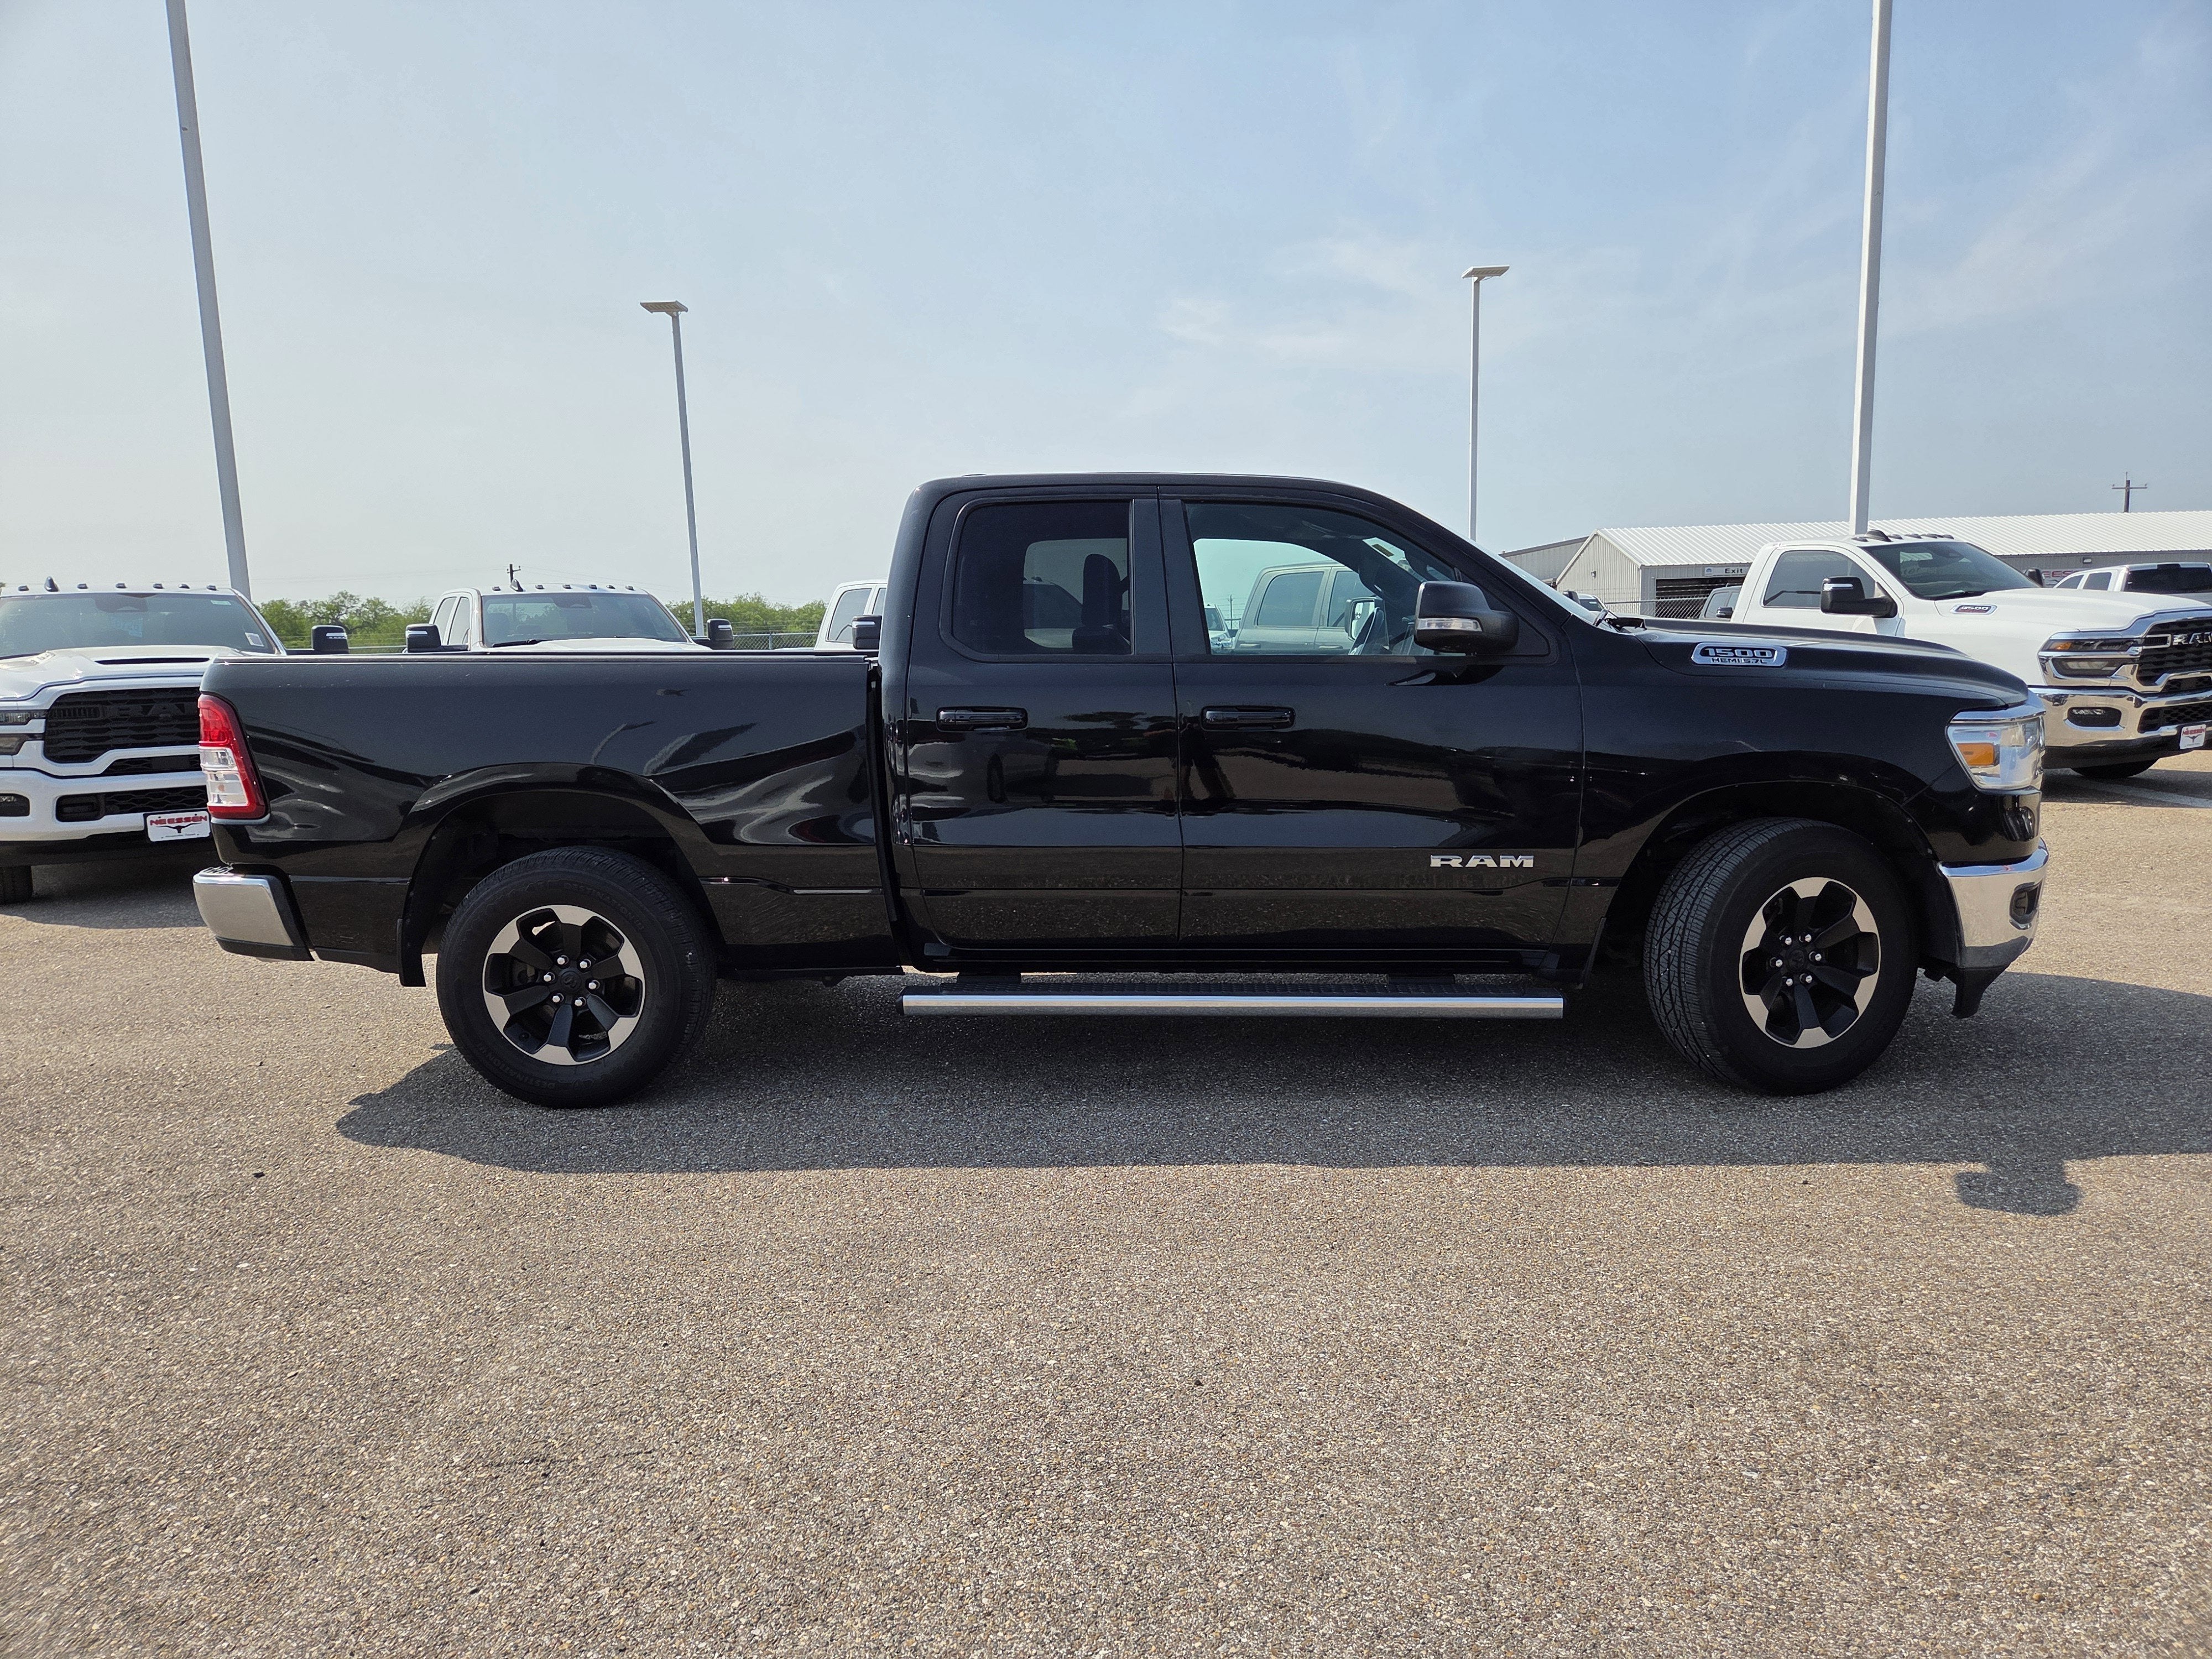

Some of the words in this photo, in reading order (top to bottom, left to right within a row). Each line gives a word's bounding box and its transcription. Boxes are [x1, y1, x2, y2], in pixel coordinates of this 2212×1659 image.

[1704, 648, 1773, 658] 1500
[149, 815, 208, 826] NEESSEN
[1430, 854, 1535, 868] RAM
